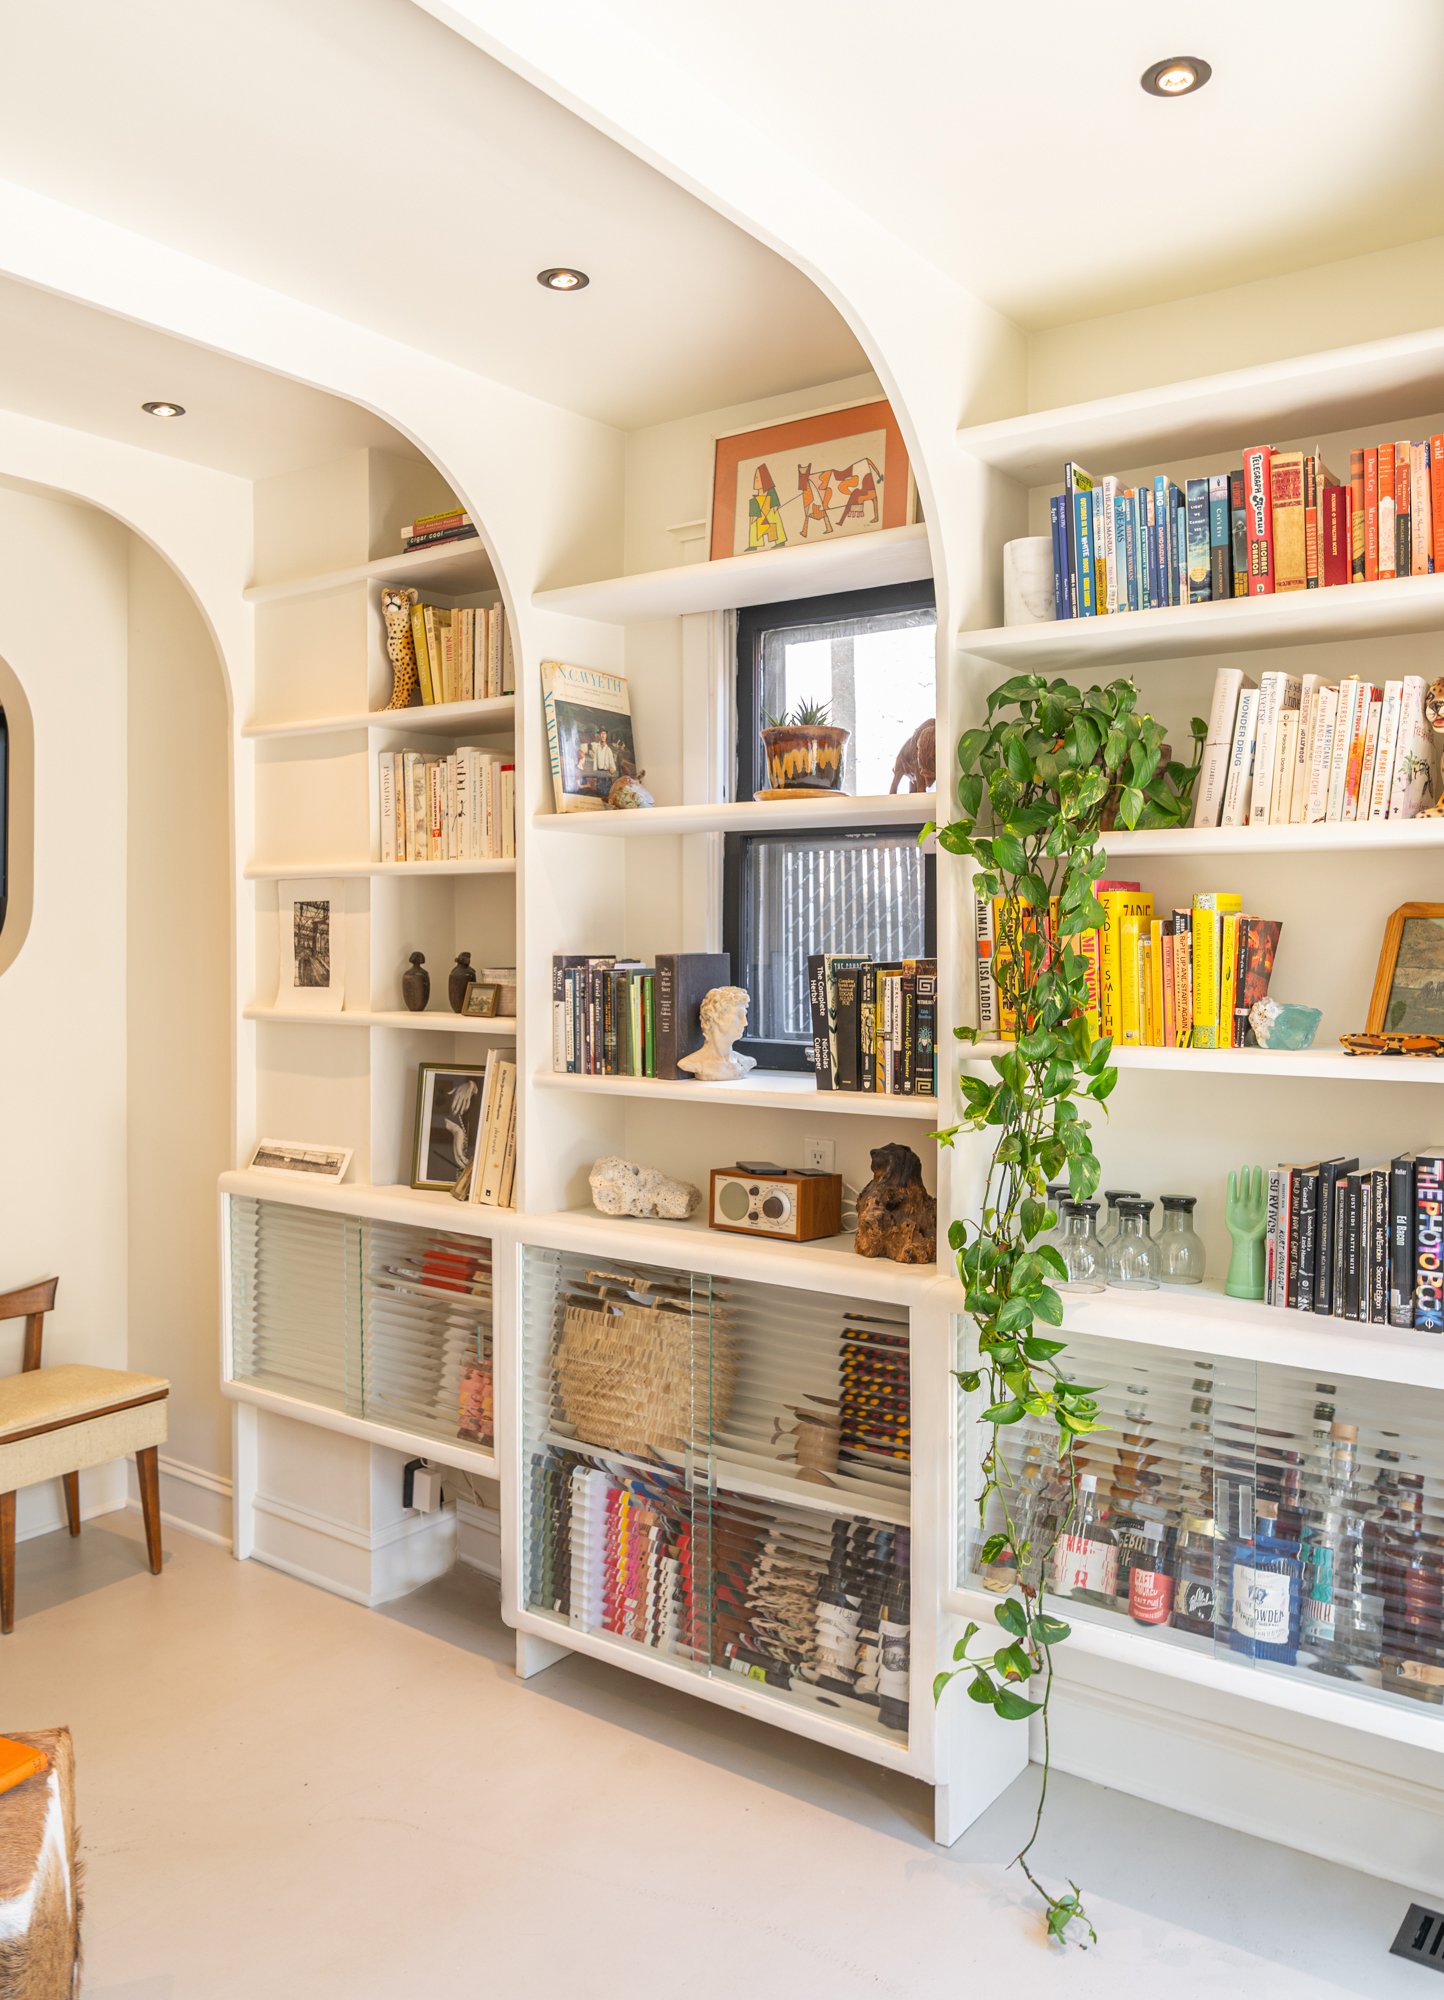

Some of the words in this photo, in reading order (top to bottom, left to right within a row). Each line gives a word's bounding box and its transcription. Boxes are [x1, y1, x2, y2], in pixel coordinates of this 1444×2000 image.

[1252, 455, 1263, 493] TELEGRAPH
[1367, 458, 1375, 477] Don't
[1156, 491, 1164, 506] BIG
[1367, 480, 1375, 492] Cry
[1082, 537, 1090, 557] WHITE
[1260, 541, 1268, 574] MICHAEL
[1238, 695, 1250, 737] WONDER
[1234, 739, 1244, 767] DRUG
[1376, 750, 1388, 777] MICHAEL
[979, 961, 990, 981] LISA
[816, 981, 825, 1016] Complete
[980, 985, 991, 1021] TADDEO
[814, 1037, 822, 1070] Culpeper
[1396, 1225, 1406, 1246] Bacon
